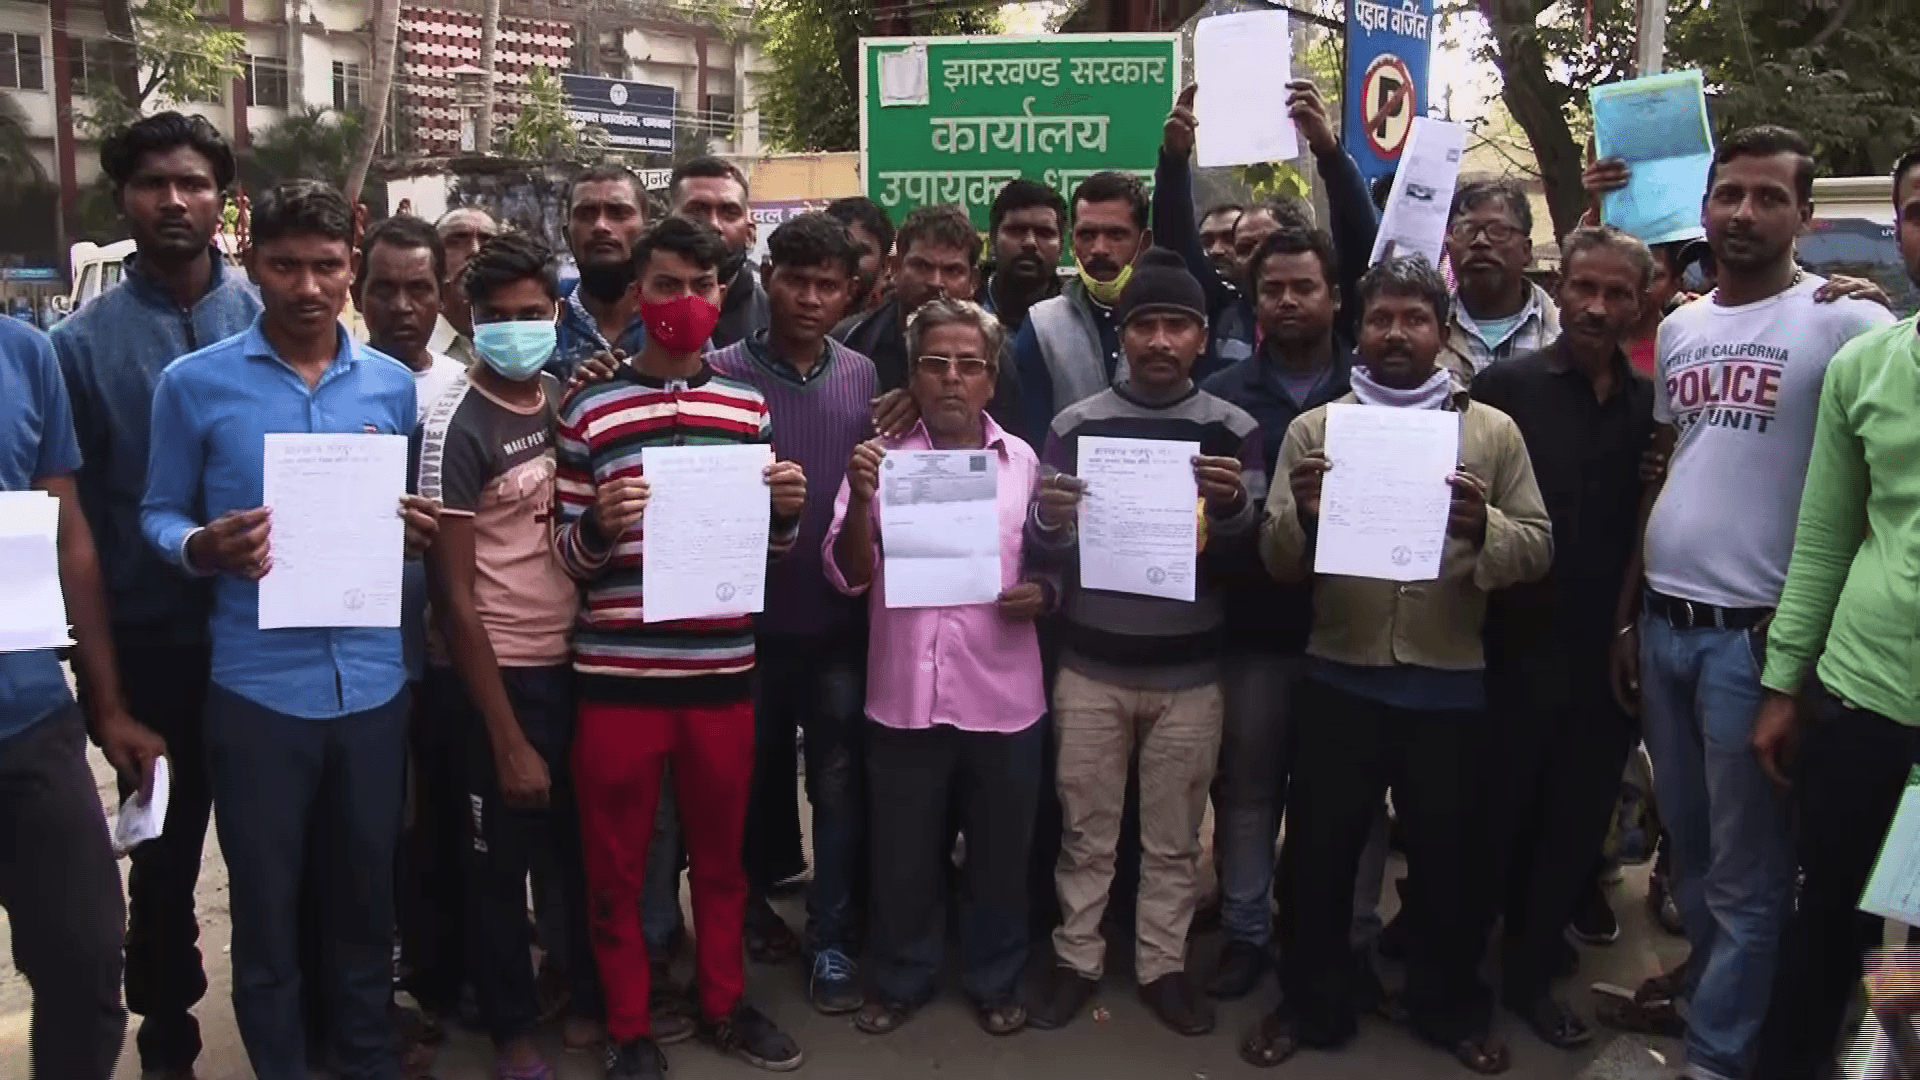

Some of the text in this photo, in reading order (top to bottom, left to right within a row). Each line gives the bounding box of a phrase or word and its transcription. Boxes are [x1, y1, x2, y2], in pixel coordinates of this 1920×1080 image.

[1355, 0, 1429, 40] पड़ाव वर्जित
[942, 56, 1167, 92] झारखण्ड सरकार
[930, 96, 1110, 153] कार्यालय
[1694, 346, 1709, 360] OF
[1711, 343, 1789, 361] CALIFORNIA
[1666, 366, 1781, 406] POLICE
[1707, 409, 1775, 434] UNIT
